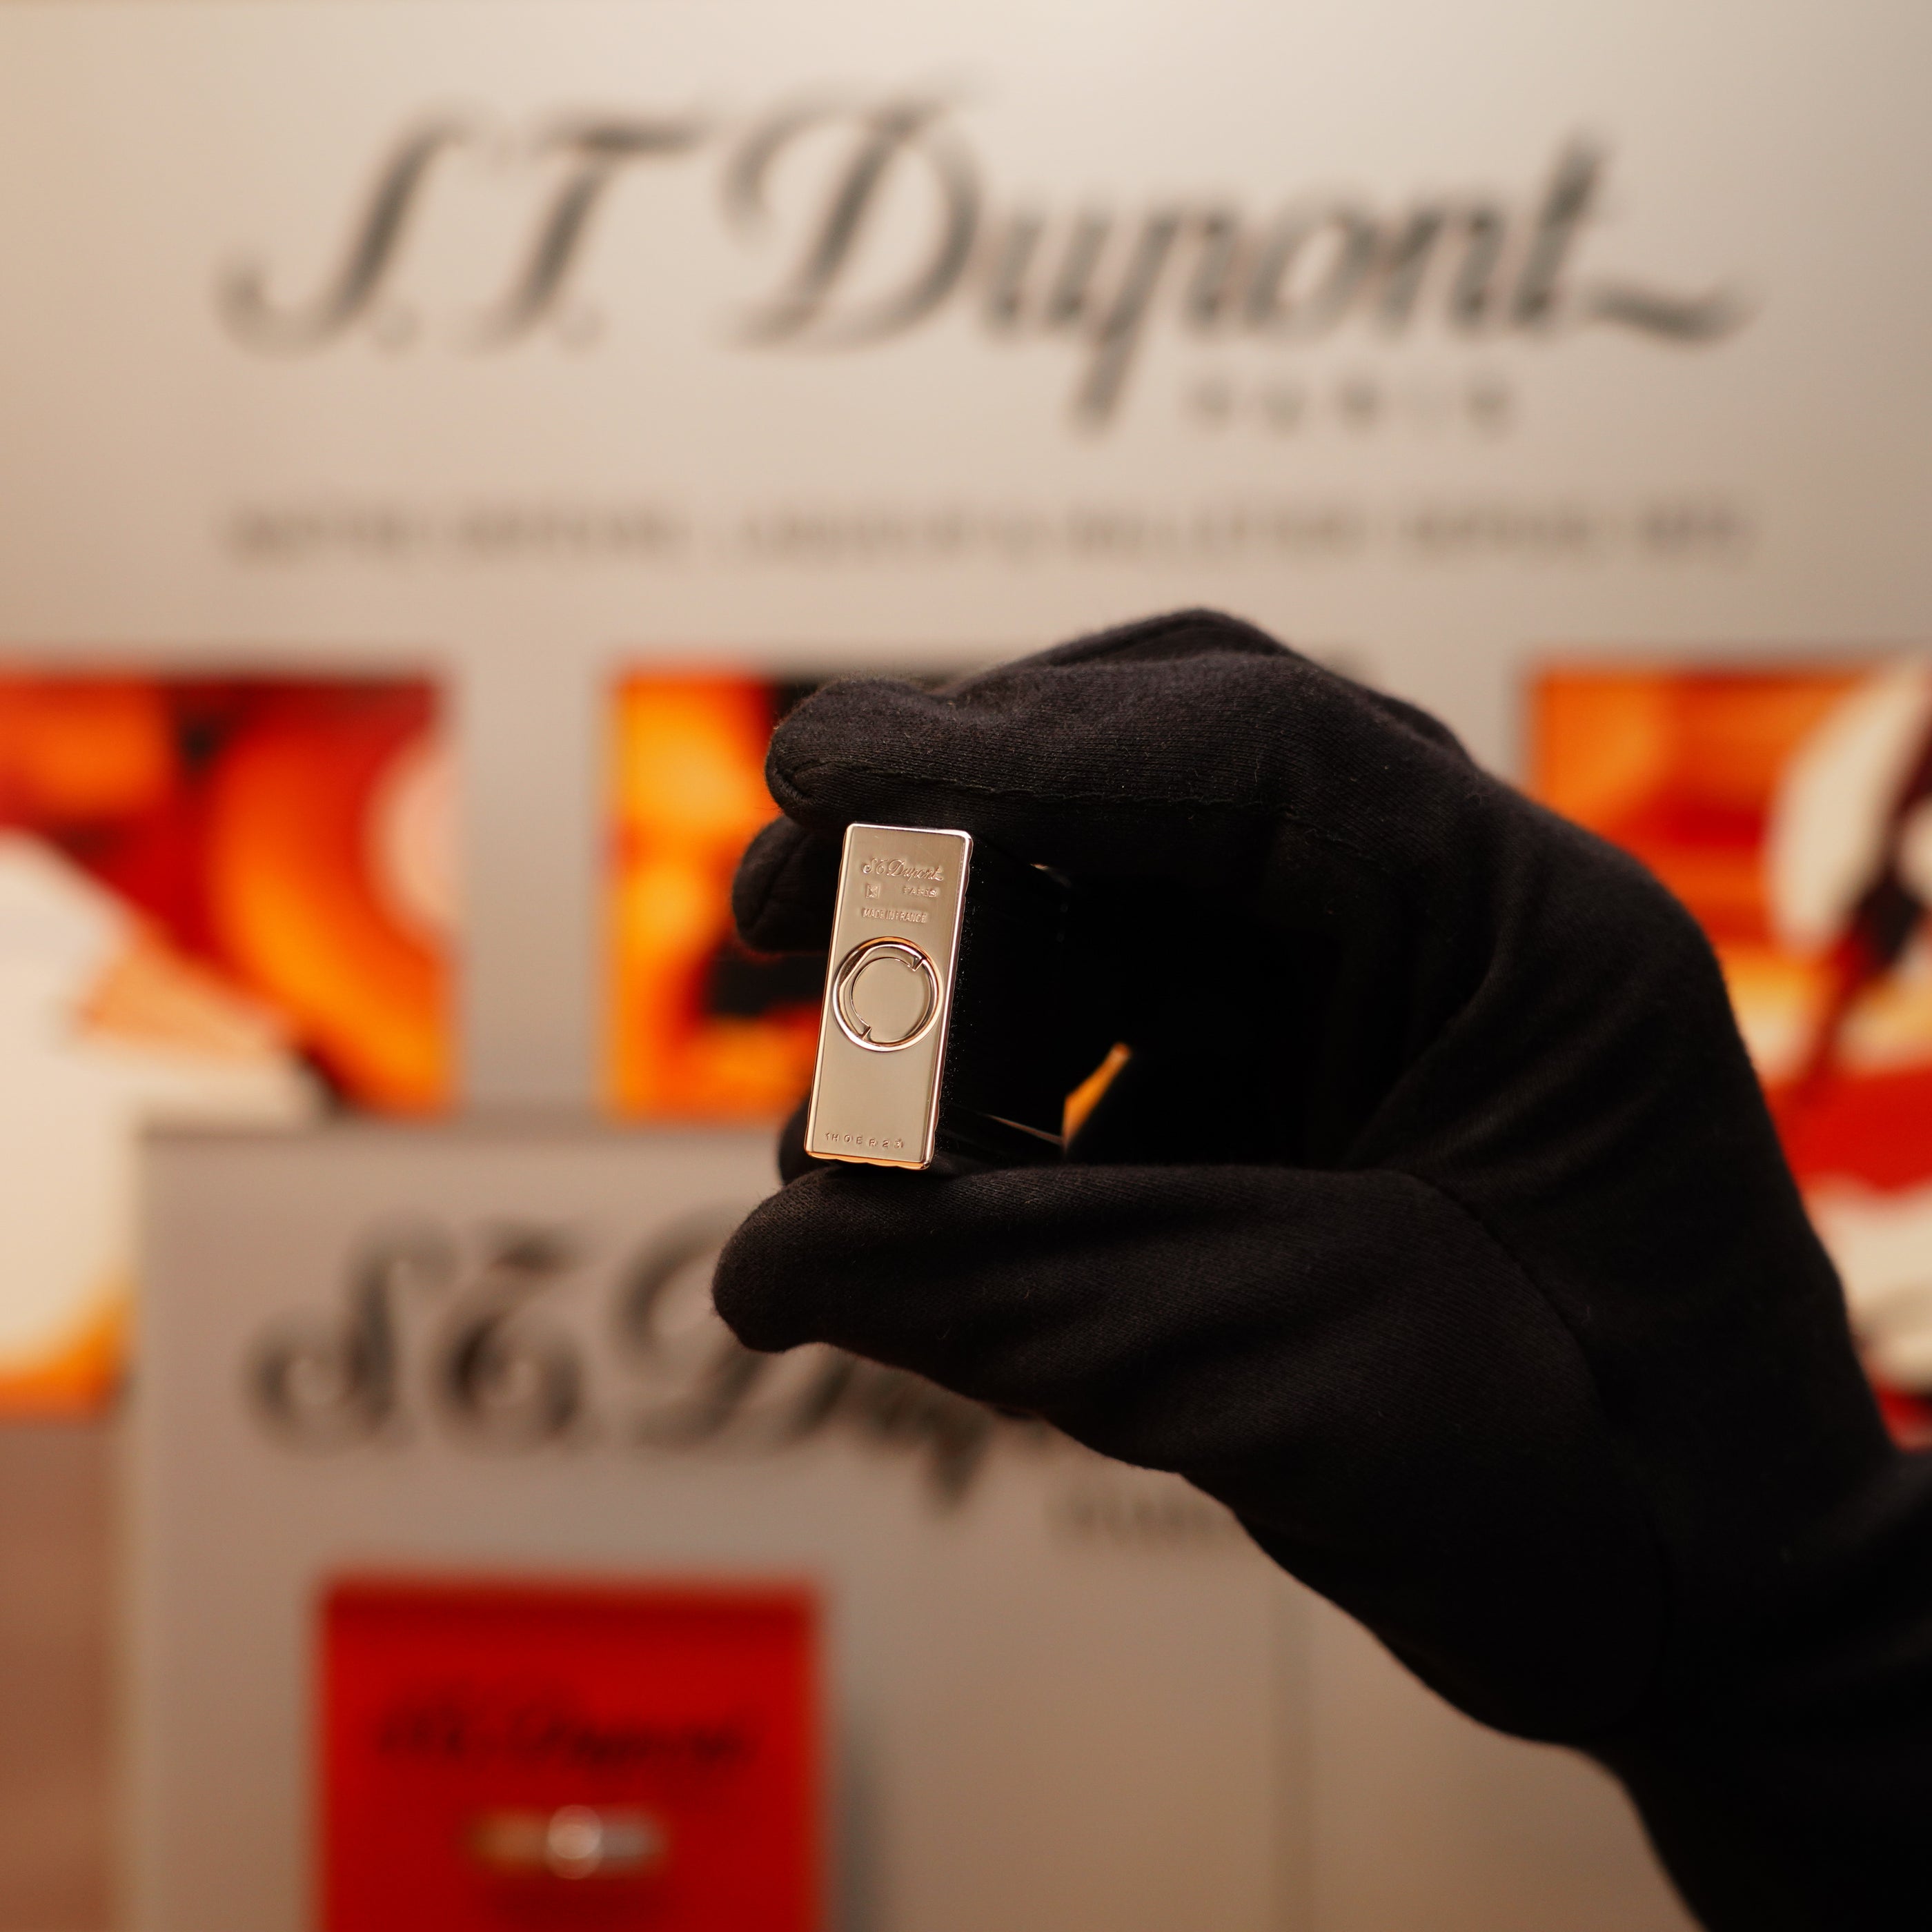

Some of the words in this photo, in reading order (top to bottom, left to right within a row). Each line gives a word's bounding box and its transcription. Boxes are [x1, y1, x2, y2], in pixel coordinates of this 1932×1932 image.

[714, 79, 1756, 436] Dupont
[887, 859, 944, 881] Dupont
[903, 887, 939, 898] PARIS
[862, 908, 885, 919] MADE
[886, 909, 895, 920] IN
[896, 911, 928, 923] FRANCE
